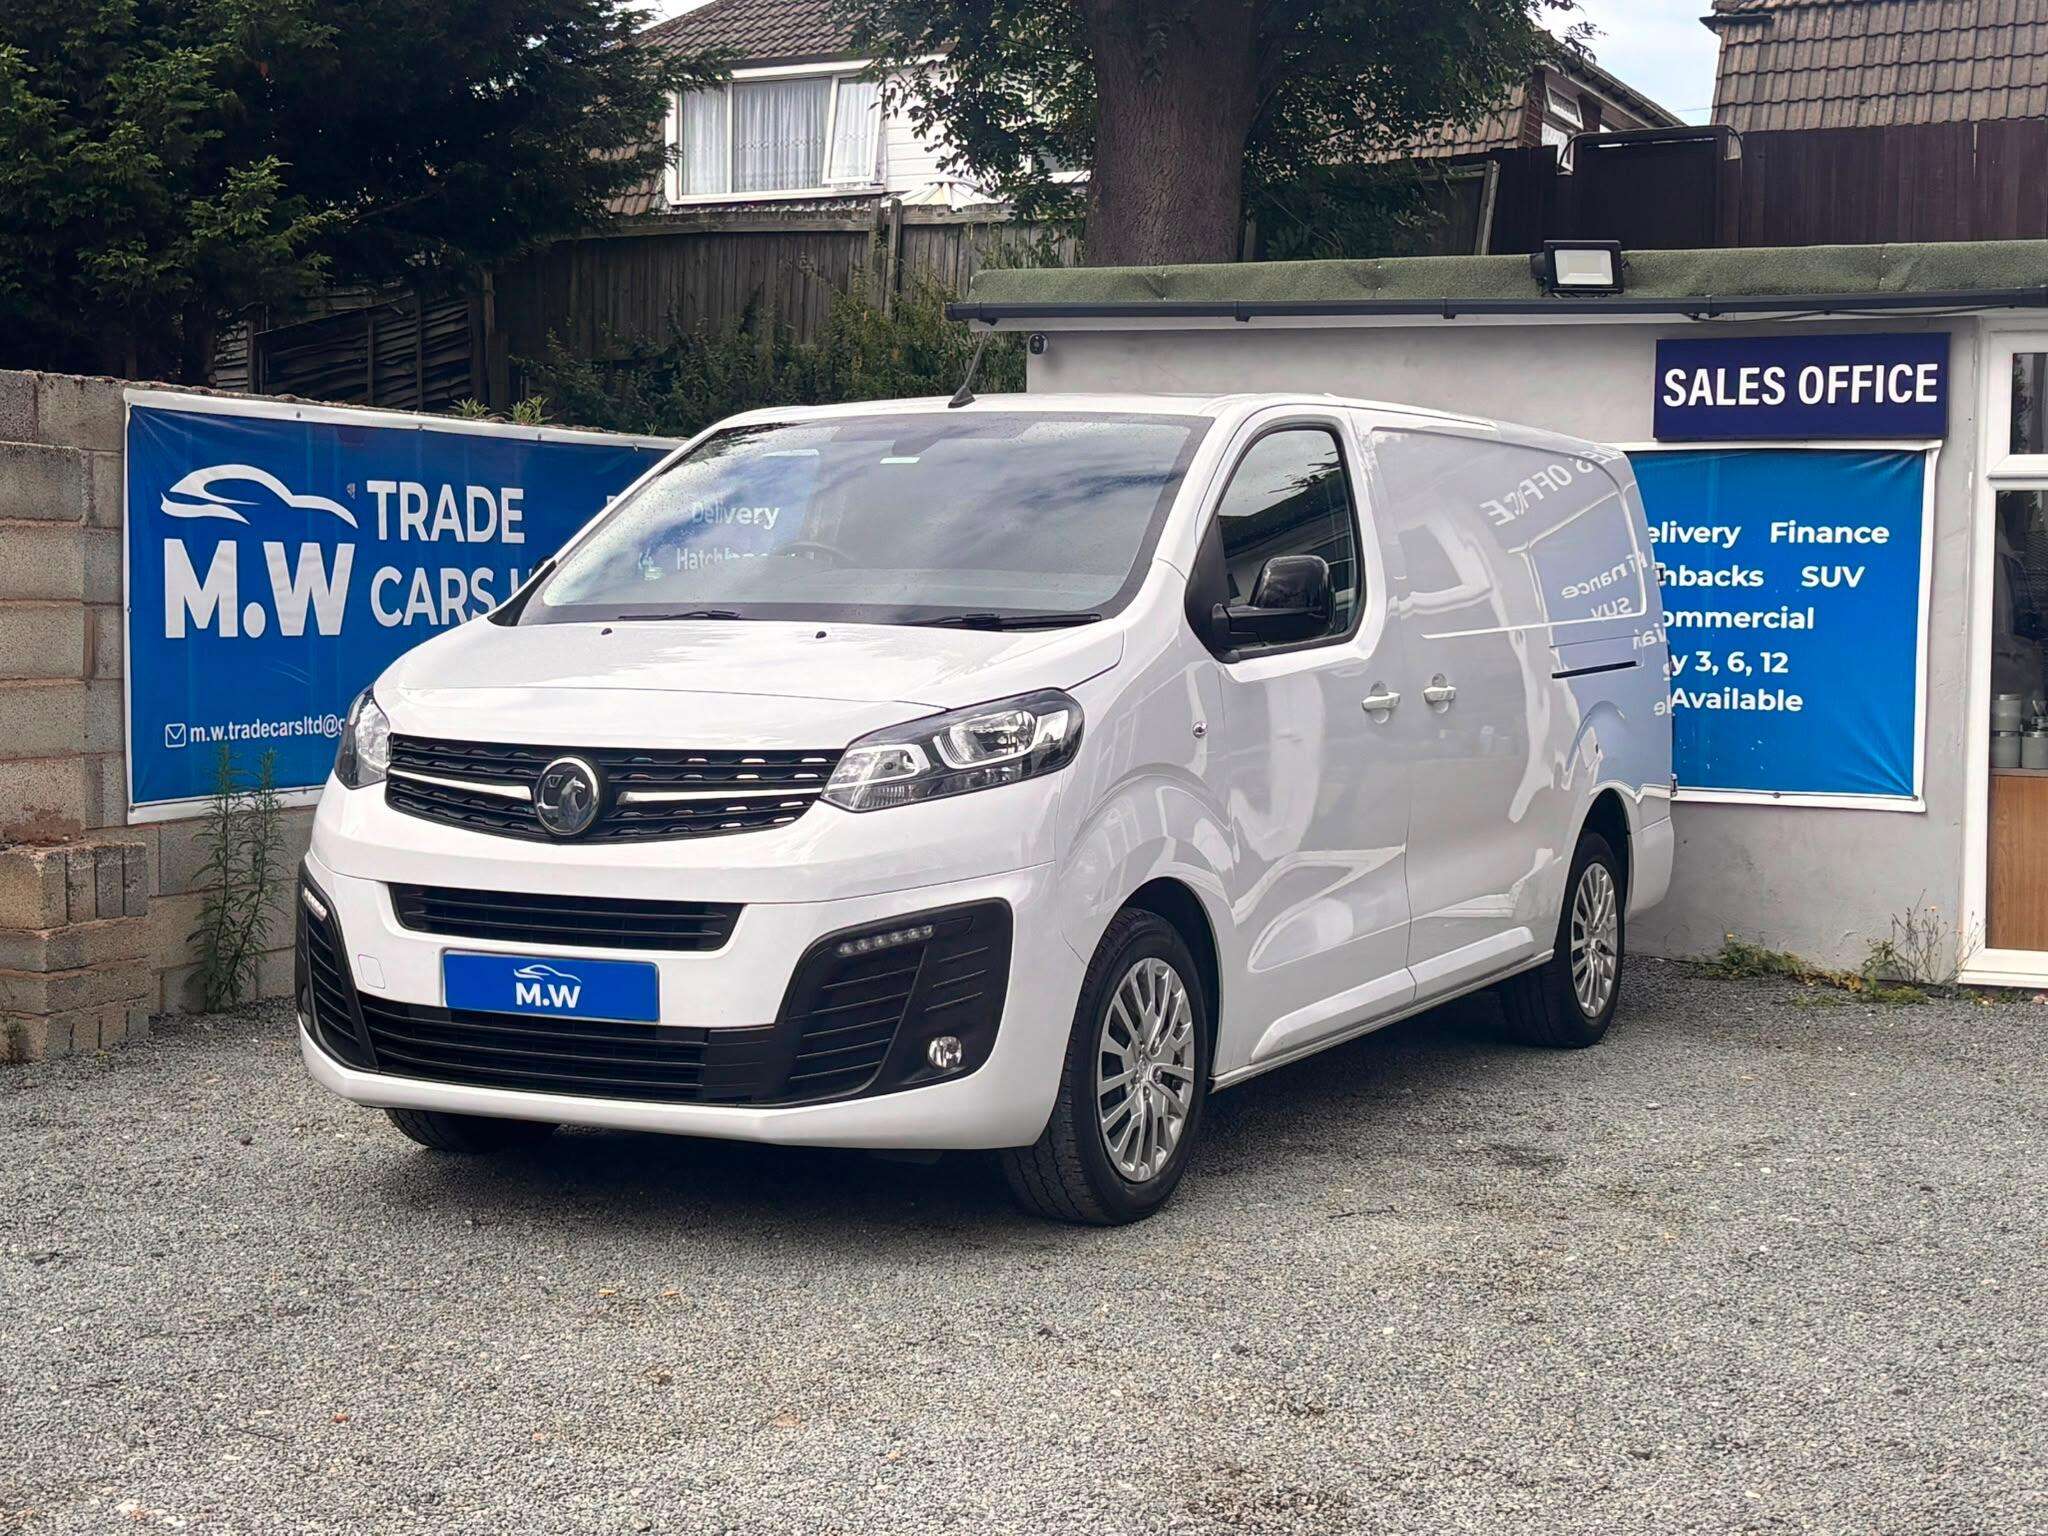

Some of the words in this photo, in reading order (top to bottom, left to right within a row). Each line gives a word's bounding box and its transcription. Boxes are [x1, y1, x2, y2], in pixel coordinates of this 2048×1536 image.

[1663, 367, 1786, 407] SALES
[1798, 364, 1938, 404] OFFICE
[366, 480, 525, 544] TRADE
[1647, 520, 1742, 549] elivery
[1769, 520, 1890, 544] Finance
[164, 539, 356, 639] M.W
[1662, 564, 1765, 588] hbacks
[1801, 565, 1865, 588] SUV
[370, 566, 497, 627] CARS
[1663, 605, 1814, 630] ommercial
[1671, 654, 1689, 677] y
[1695, 651, 1719, 676] 3,
[1727, 651, 1753, 677] 6,
[1760, 651, 1789, 673] 12
[1672, 687, 1803, 712] Available
[190, 714, 346, 742] m.w.tradecarsltd@g
[515, 981, 581, 1008] M.W
